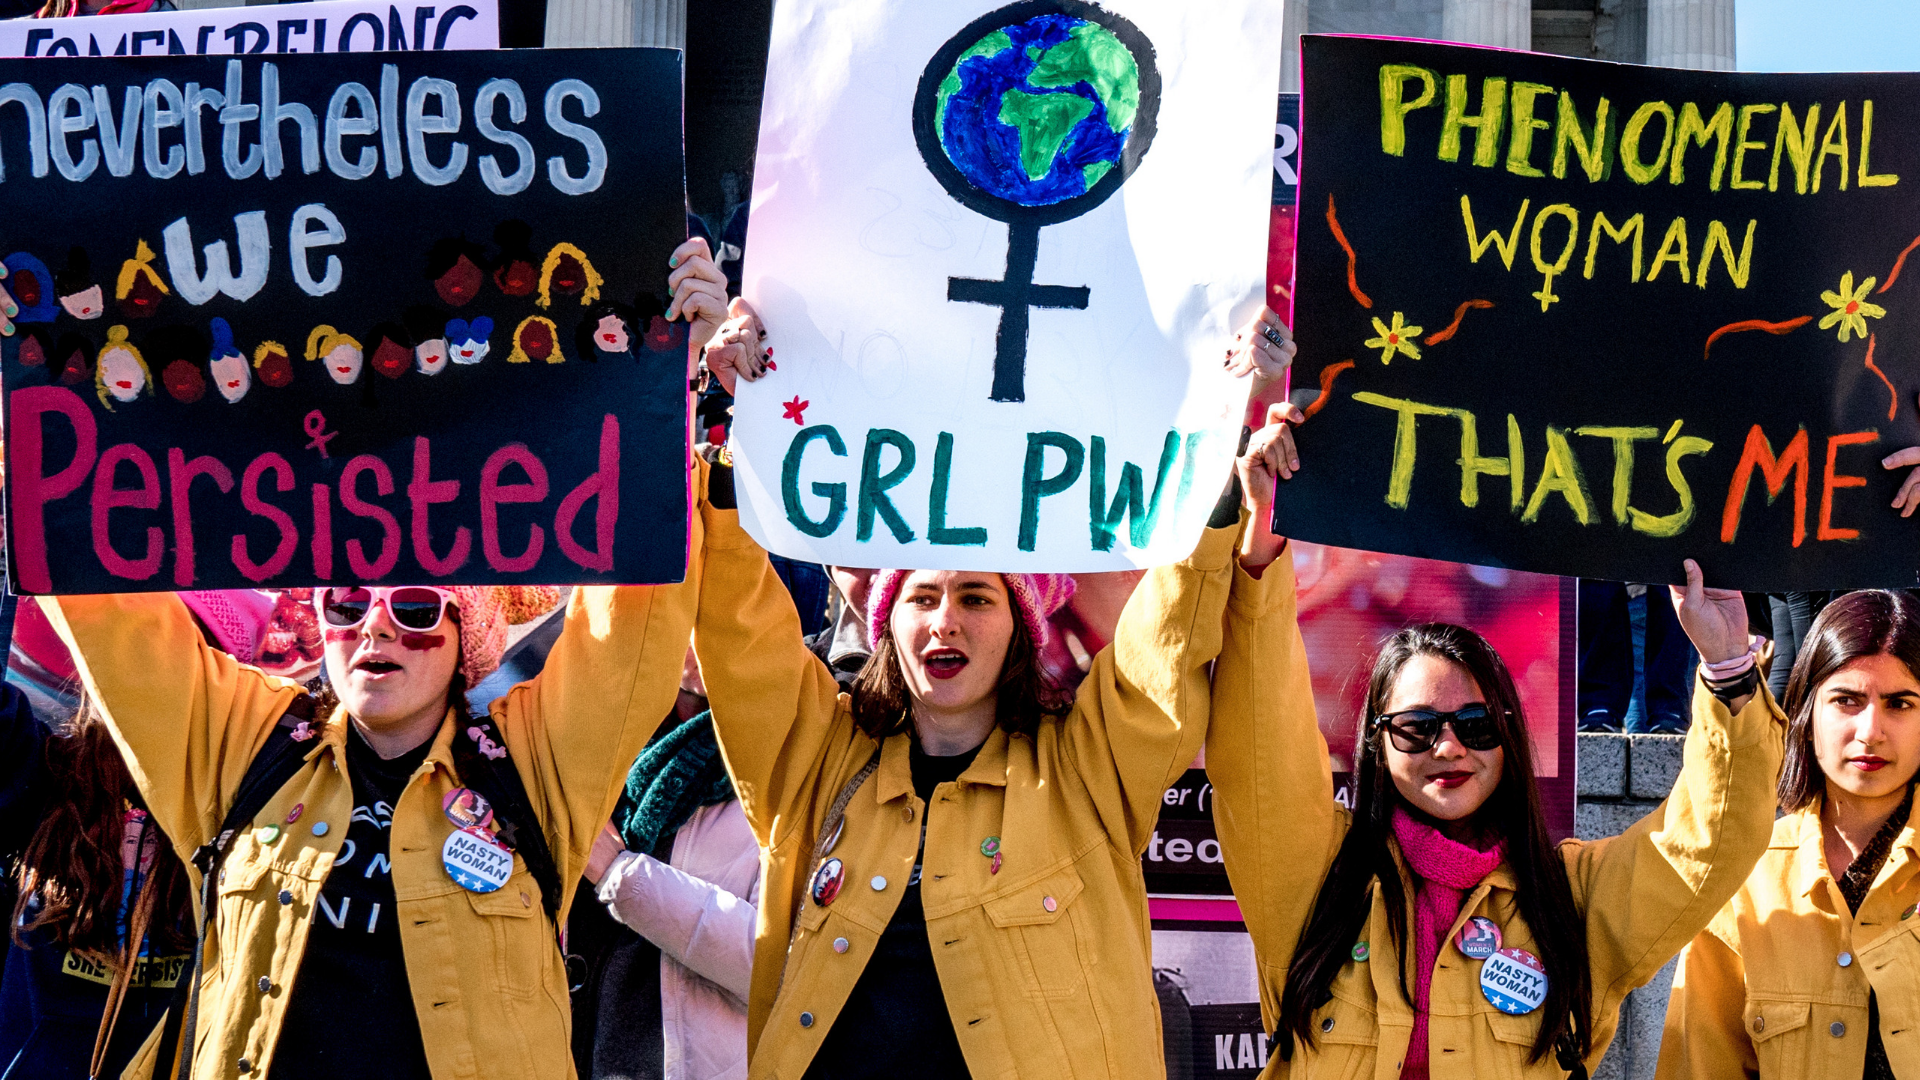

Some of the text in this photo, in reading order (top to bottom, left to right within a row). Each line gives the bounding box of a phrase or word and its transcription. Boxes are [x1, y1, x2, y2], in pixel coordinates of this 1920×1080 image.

[0, 59, 608, 195] nevertheless
[1379, 62, 1900, 195] PHENOMENAL
[163, 203, 346, 306] we
[1460, 194, 1758, 312] WOMAN
[10, 385, 621, 594] Persisted
[780, 424, 988, 547] GRL
[1351, 392, 1879, 548] THAT'S ME
[446, 846, 508, 881] WOMAN
[453, 836, 509, 867] NASTY
[1483, 968, 1542, 1002] WOMAN
[1490, 959, 1543, 988] NASTY
